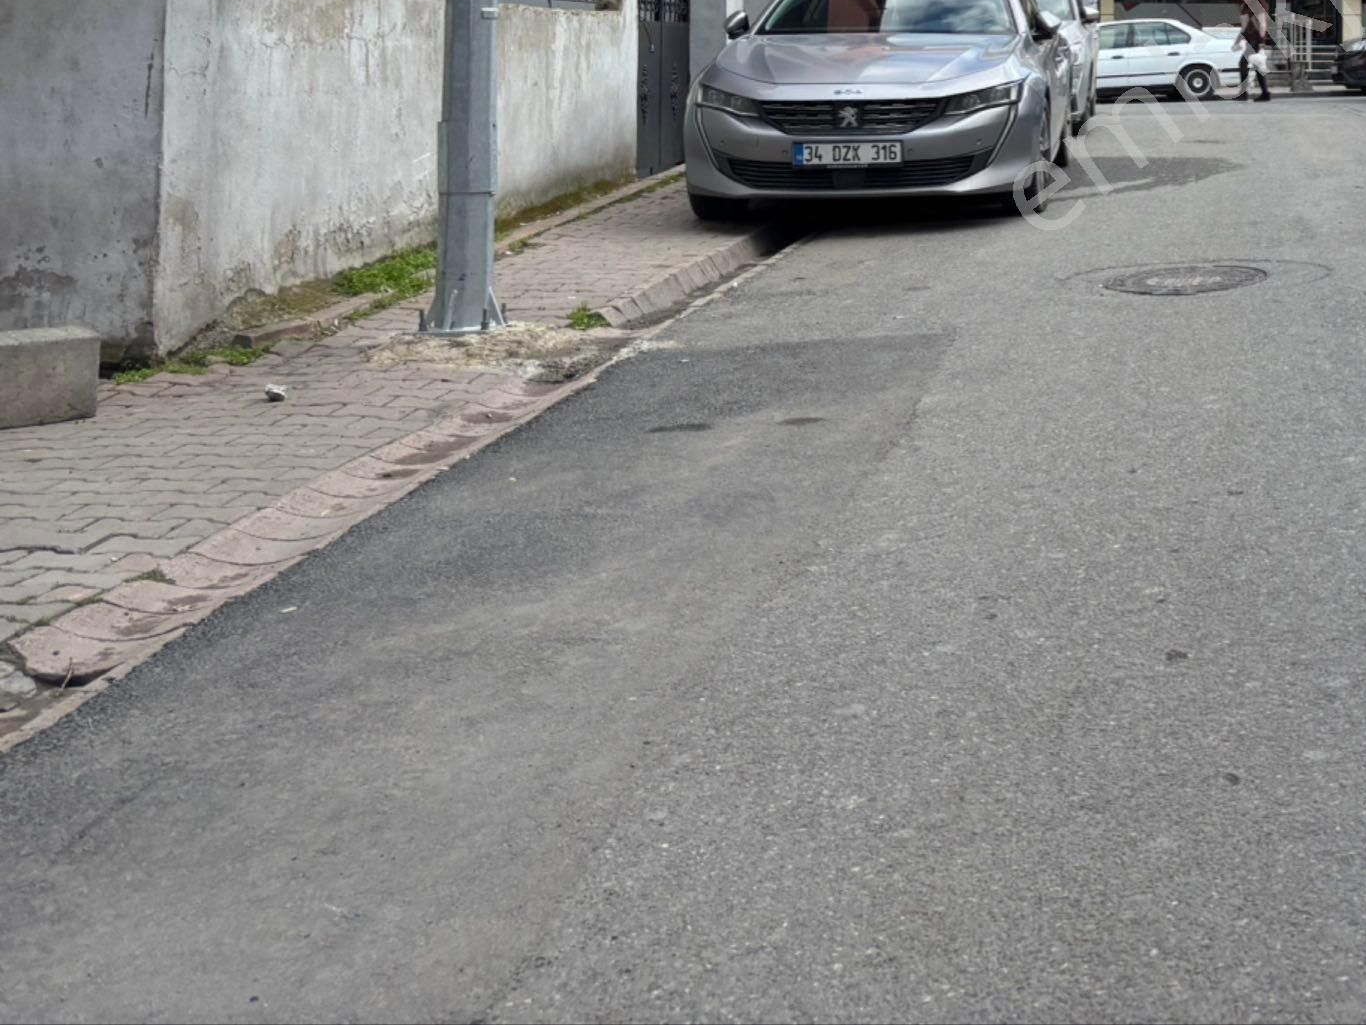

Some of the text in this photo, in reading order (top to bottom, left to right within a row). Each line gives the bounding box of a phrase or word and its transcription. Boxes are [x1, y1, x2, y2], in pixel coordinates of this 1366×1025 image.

[804, 144, 897, 162] 34 DZK 316
